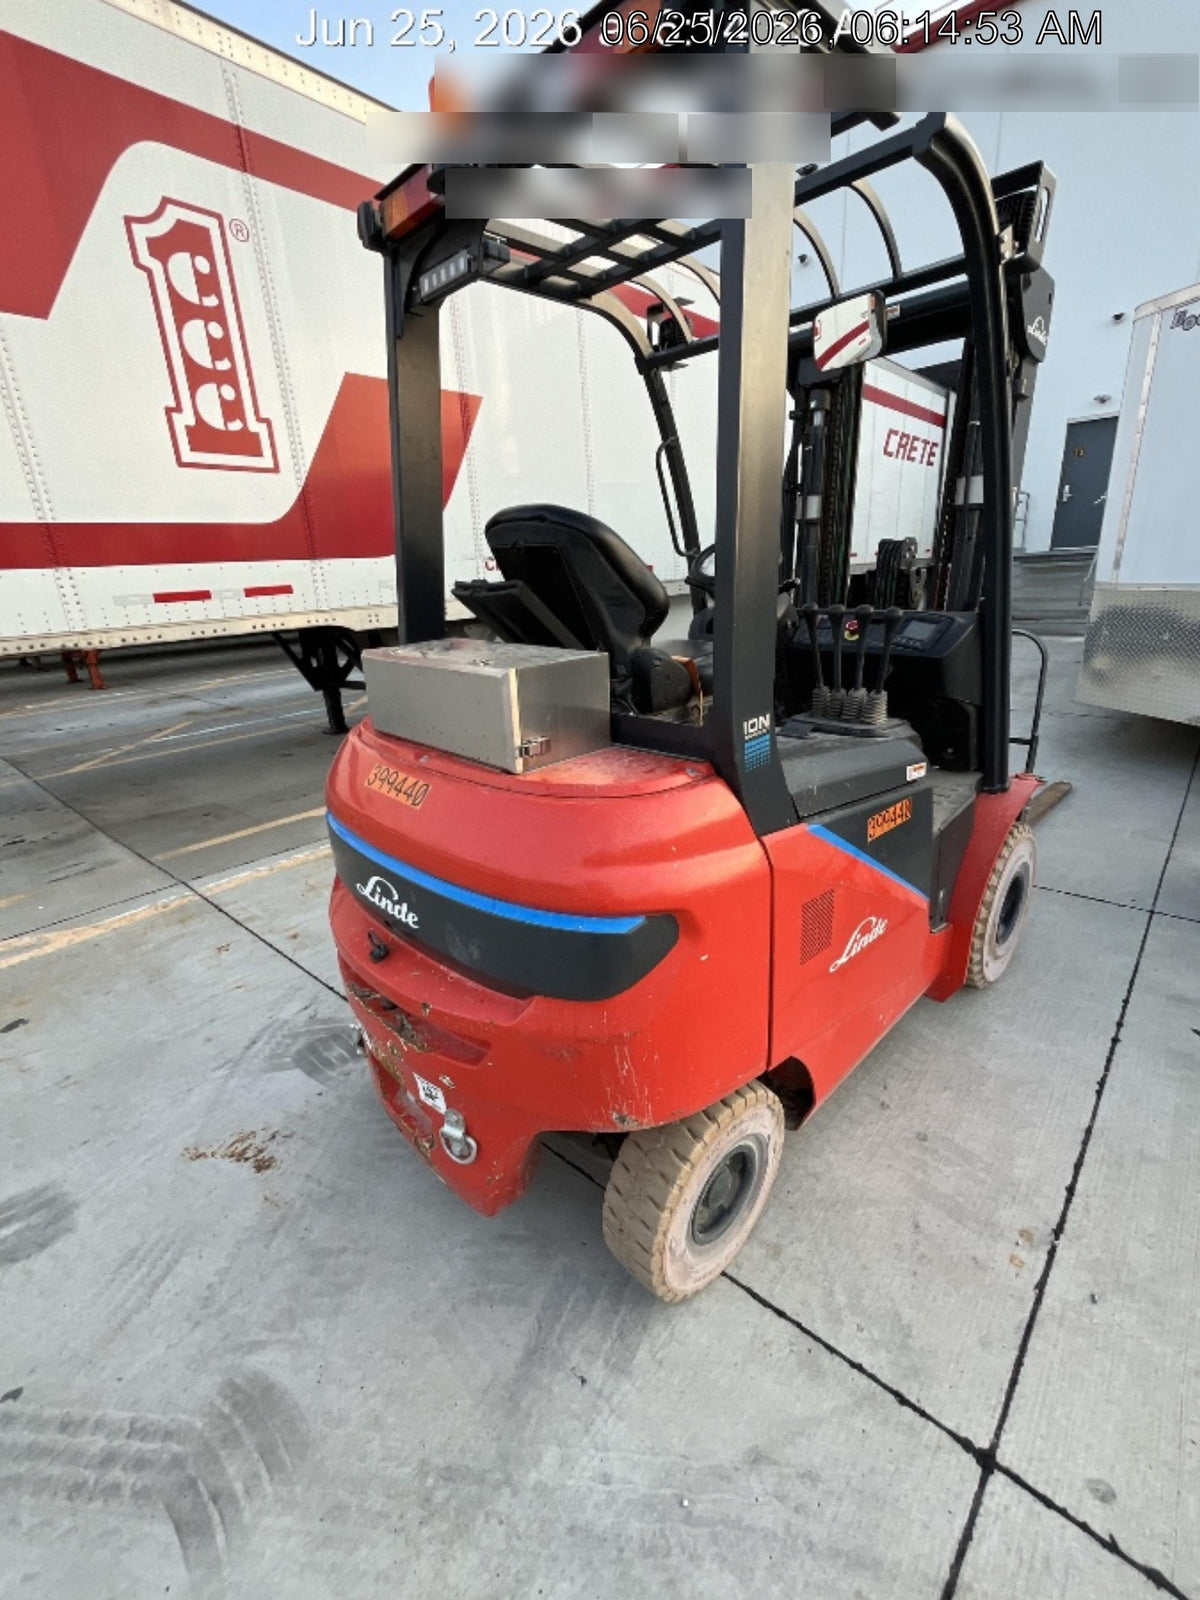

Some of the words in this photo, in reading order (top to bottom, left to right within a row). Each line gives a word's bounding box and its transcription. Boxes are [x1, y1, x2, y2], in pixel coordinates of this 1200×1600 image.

[883, 428, 939, 467] CRETE
[743, 713, 771, 736] ION
[367, 764, 430, 807] 399440
[356, 875, 420, 929] Linde
[829, 915, 889, 973] Linde
